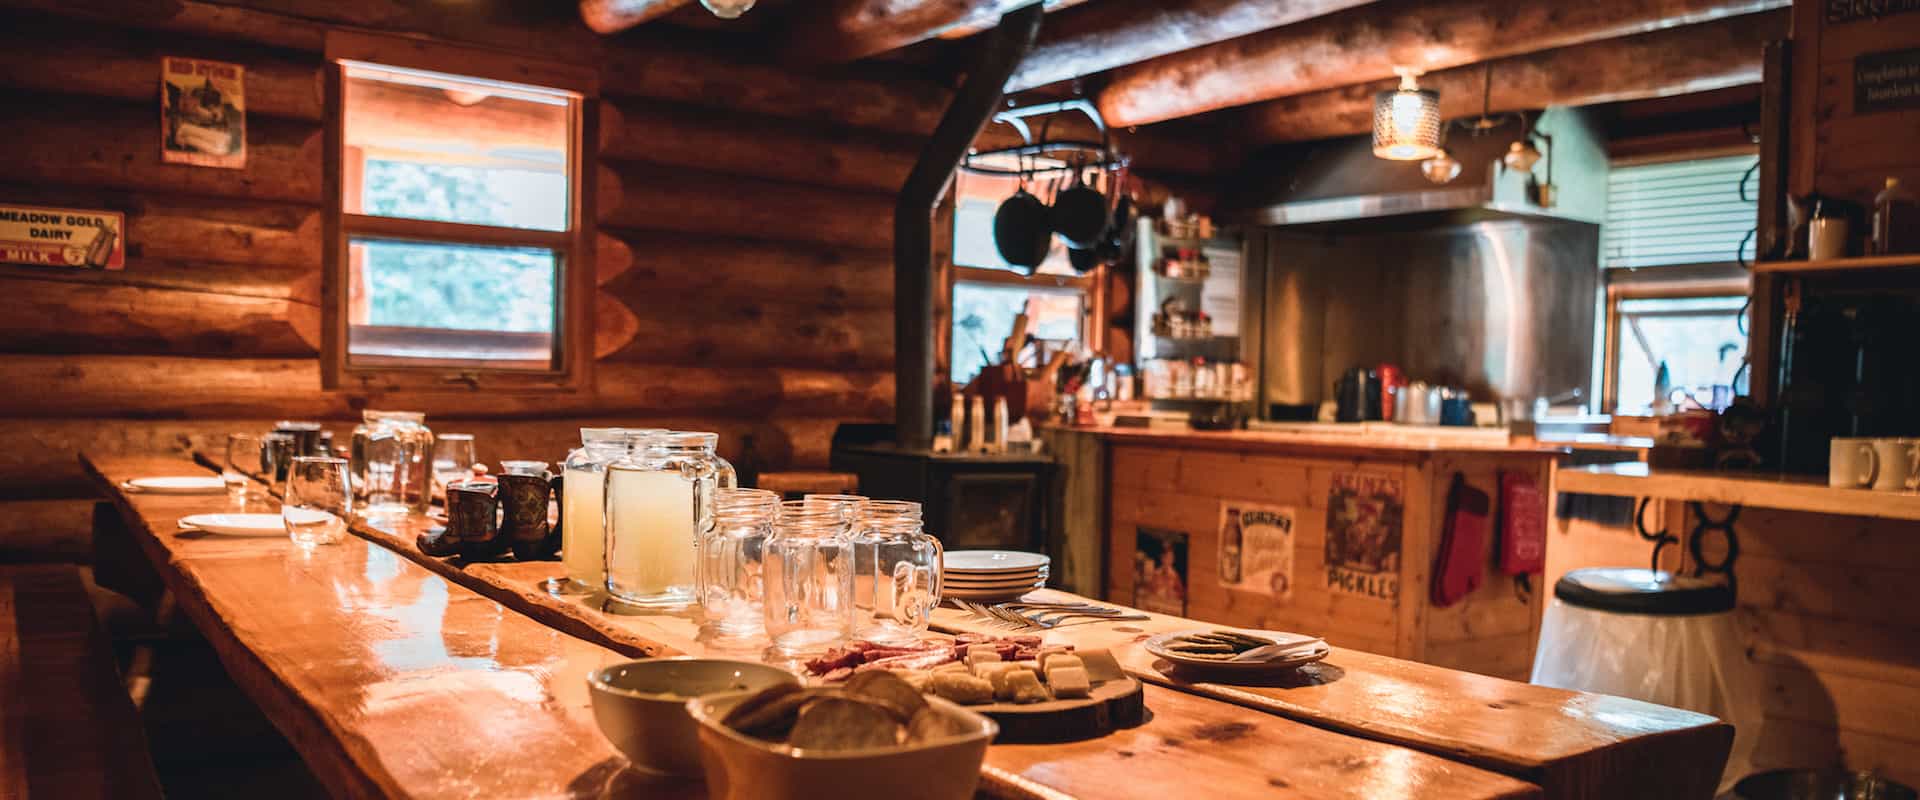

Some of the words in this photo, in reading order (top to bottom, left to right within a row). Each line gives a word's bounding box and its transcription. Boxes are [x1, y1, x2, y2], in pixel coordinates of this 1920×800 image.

[0, 211, 61, 225] MEADOW
[66, 216, 104, 229] GOLD
[30, 228, 72, 240] DAIRY
[6, 248, 48, 262] MILK
[1328, 568, 1399, 601] PICKLES
